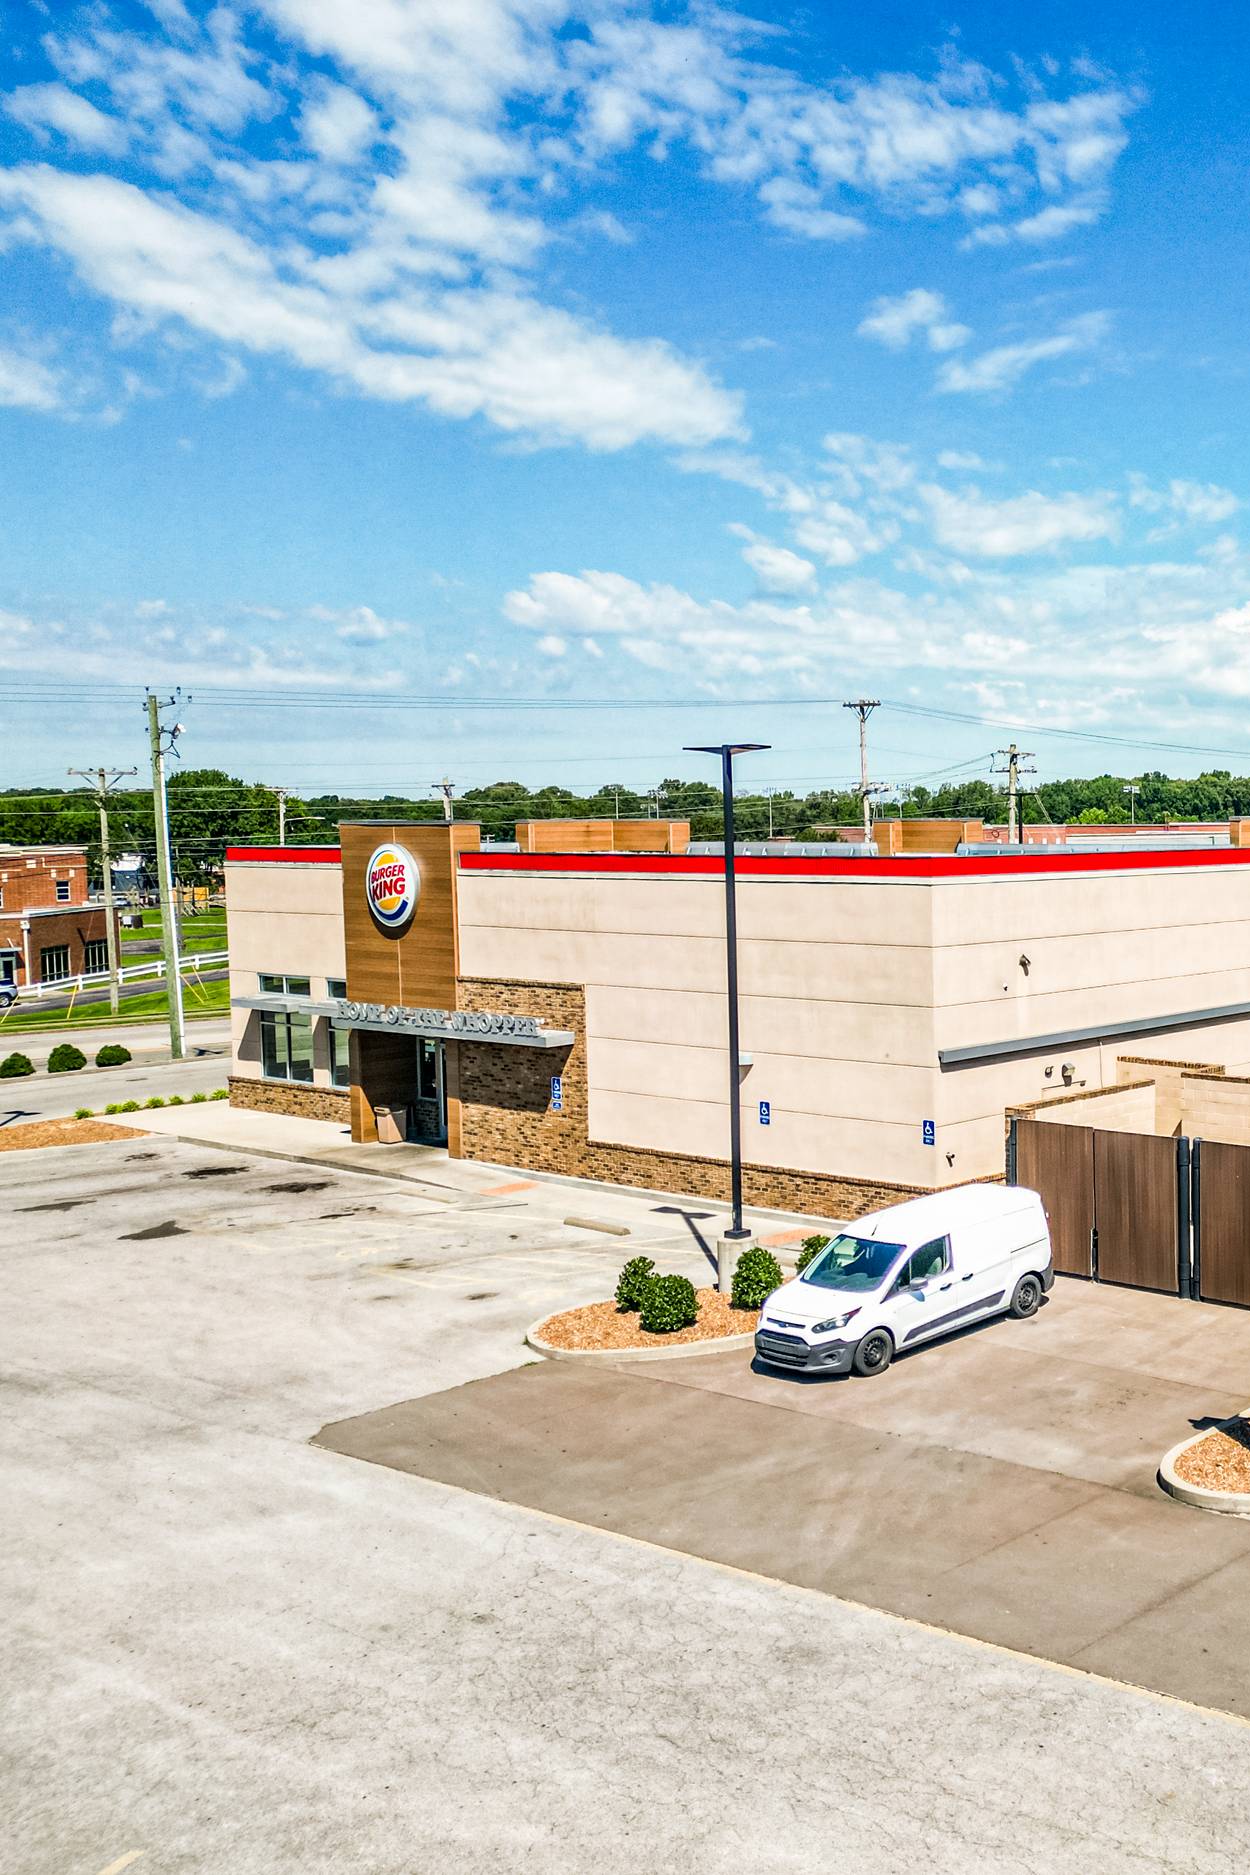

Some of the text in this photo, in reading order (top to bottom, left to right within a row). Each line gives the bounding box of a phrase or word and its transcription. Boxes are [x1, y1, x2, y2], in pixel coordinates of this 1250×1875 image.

[371, 865, 405, 883] BURGER
[372, 877, 406, 902] KING
[337, 1001, 383, 1024] HOME
[451, 1012, 539, 1037] WHOPPER
